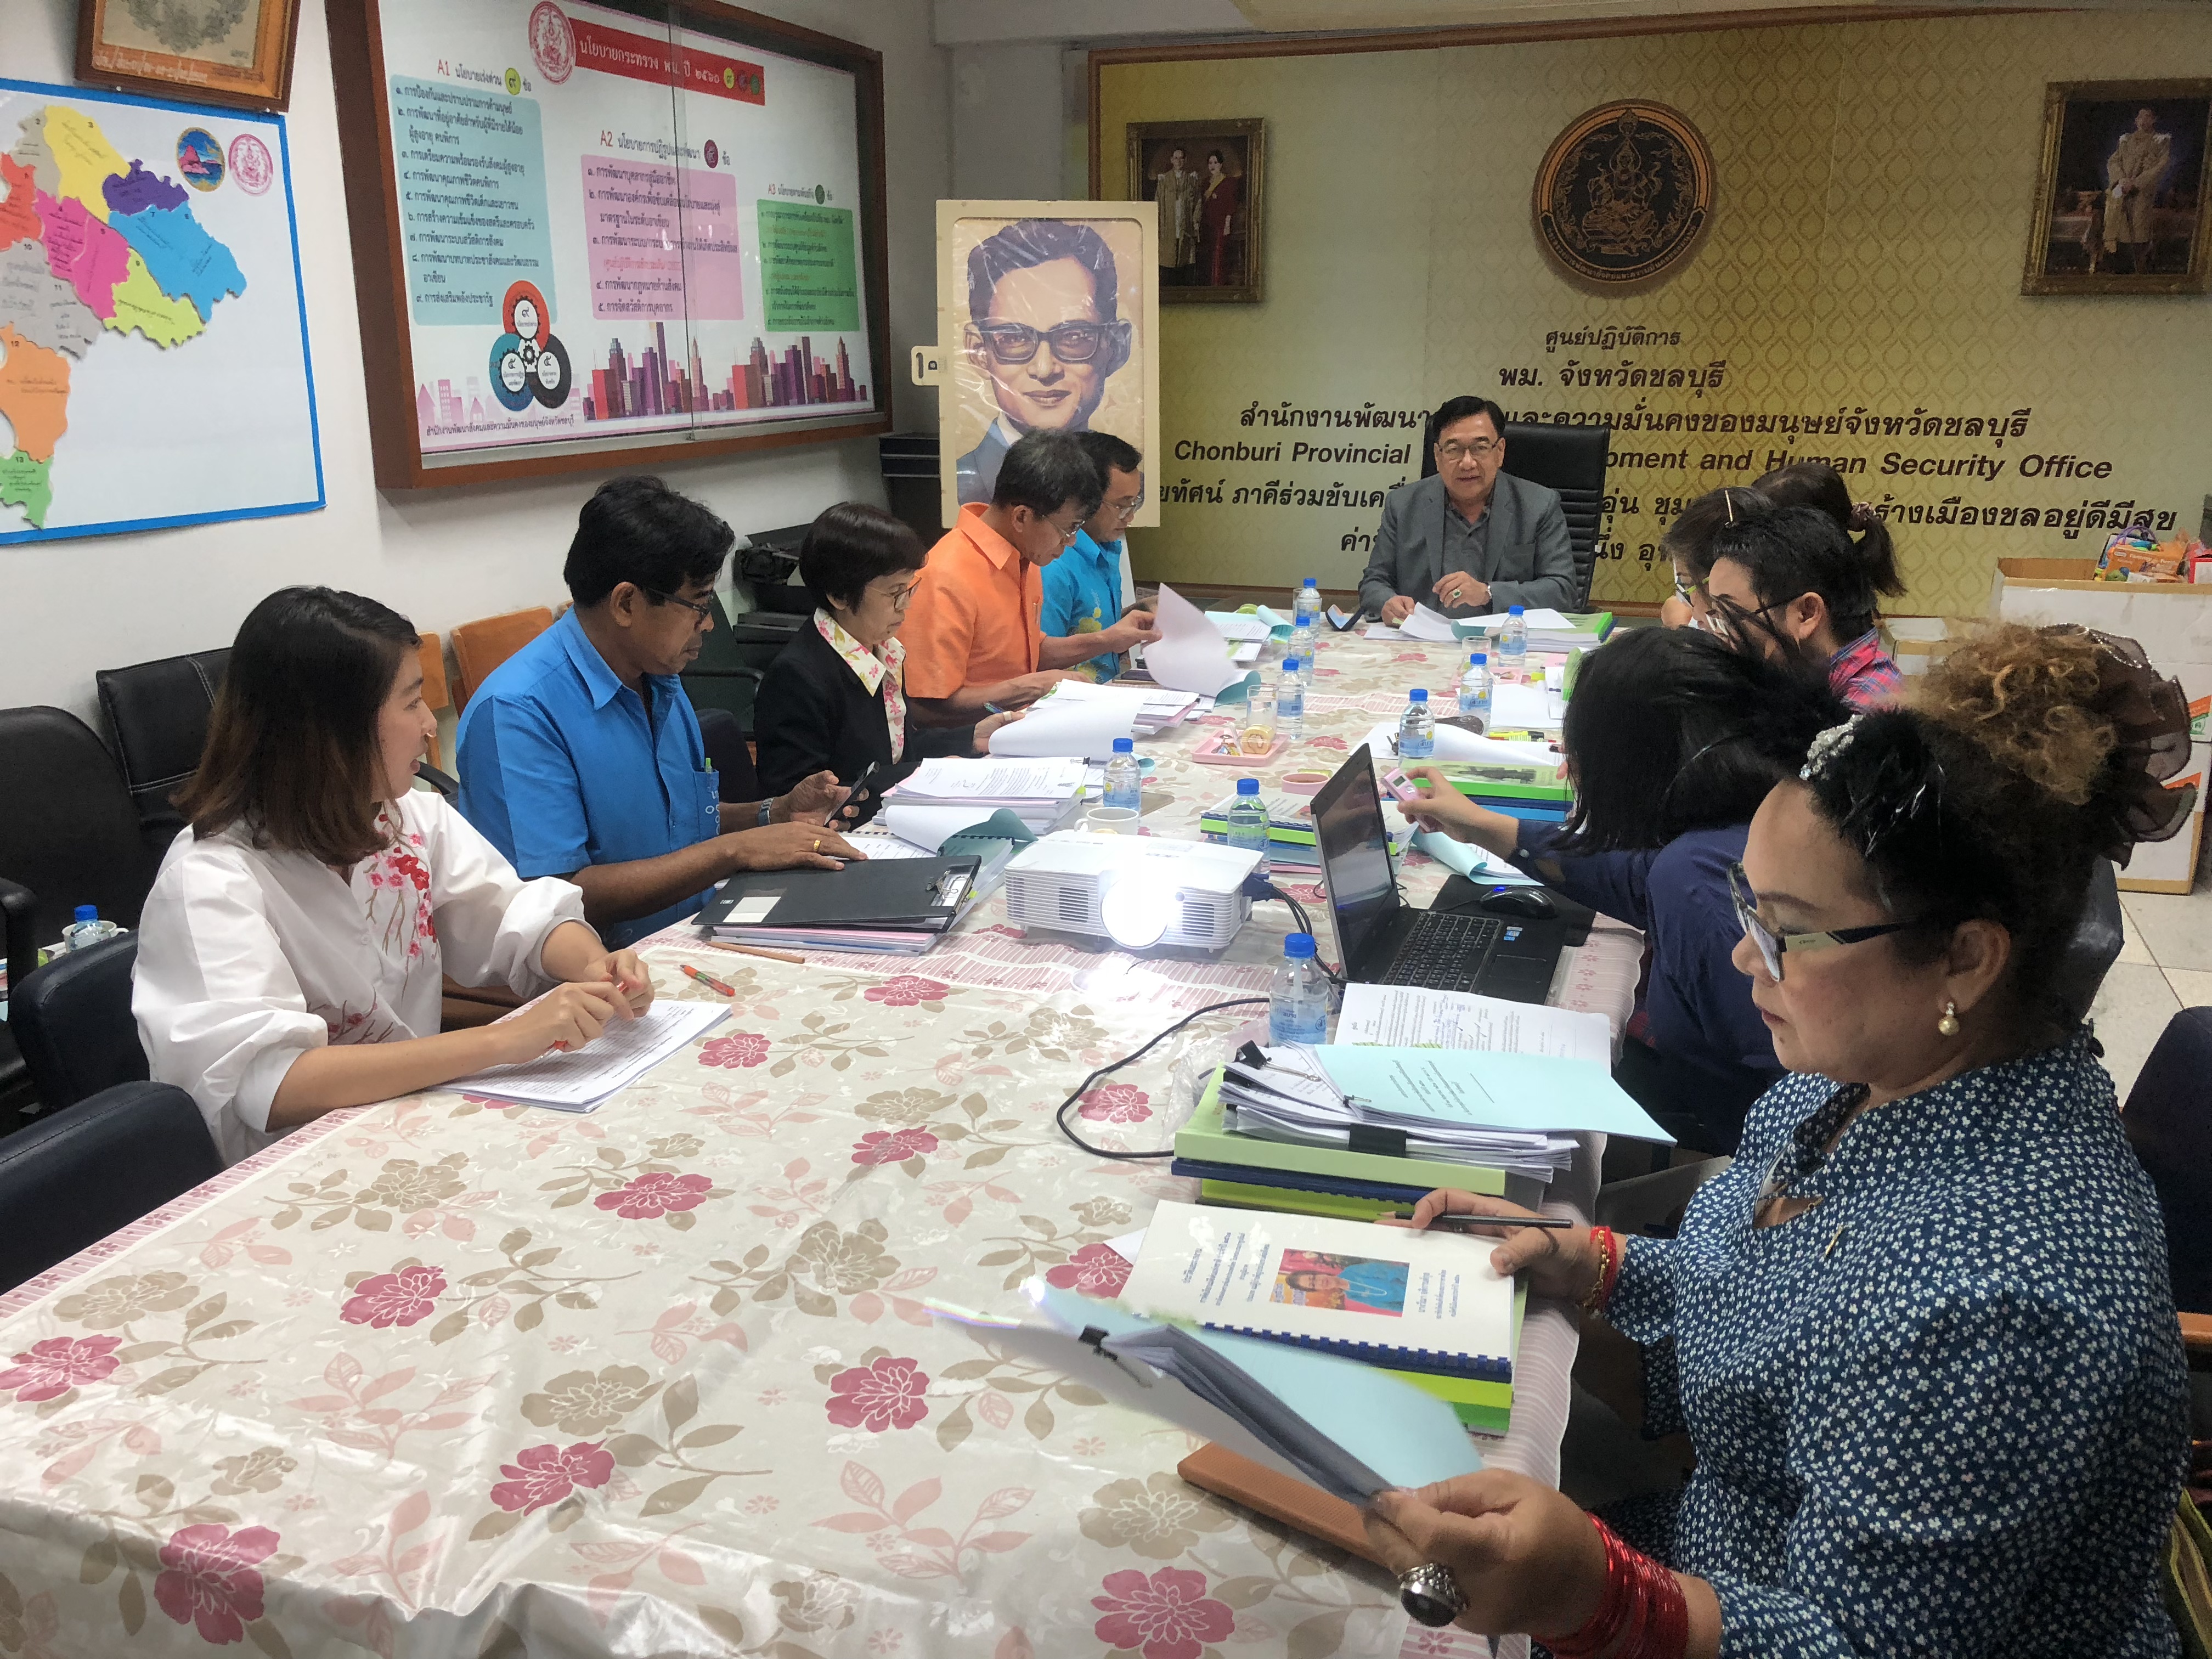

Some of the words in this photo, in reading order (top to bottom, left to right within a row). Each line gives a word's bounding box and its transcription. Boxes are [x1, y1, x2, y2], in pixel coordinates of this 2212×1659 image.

[437, 59, 451, 76] A1
[579, 34, 659, 71] นโยบายกระทรวง
[600, 129, 613, 147] A2
[1545, 325, 1681, 353] ศูนย์ปฏิบัติการ
[1499, 364, 1543, 387] พม.
[1559, 359, 1726, 399] จังหวัดชลบุรี
[1174, 439, 1282, 462] Chonburi
[1291, 442, 1412, 464] Provincial
[1700, 450, 1753, 471] and
[1880, 452, 2005, 481] Security
[2019, 454, 2112, 478] Office
